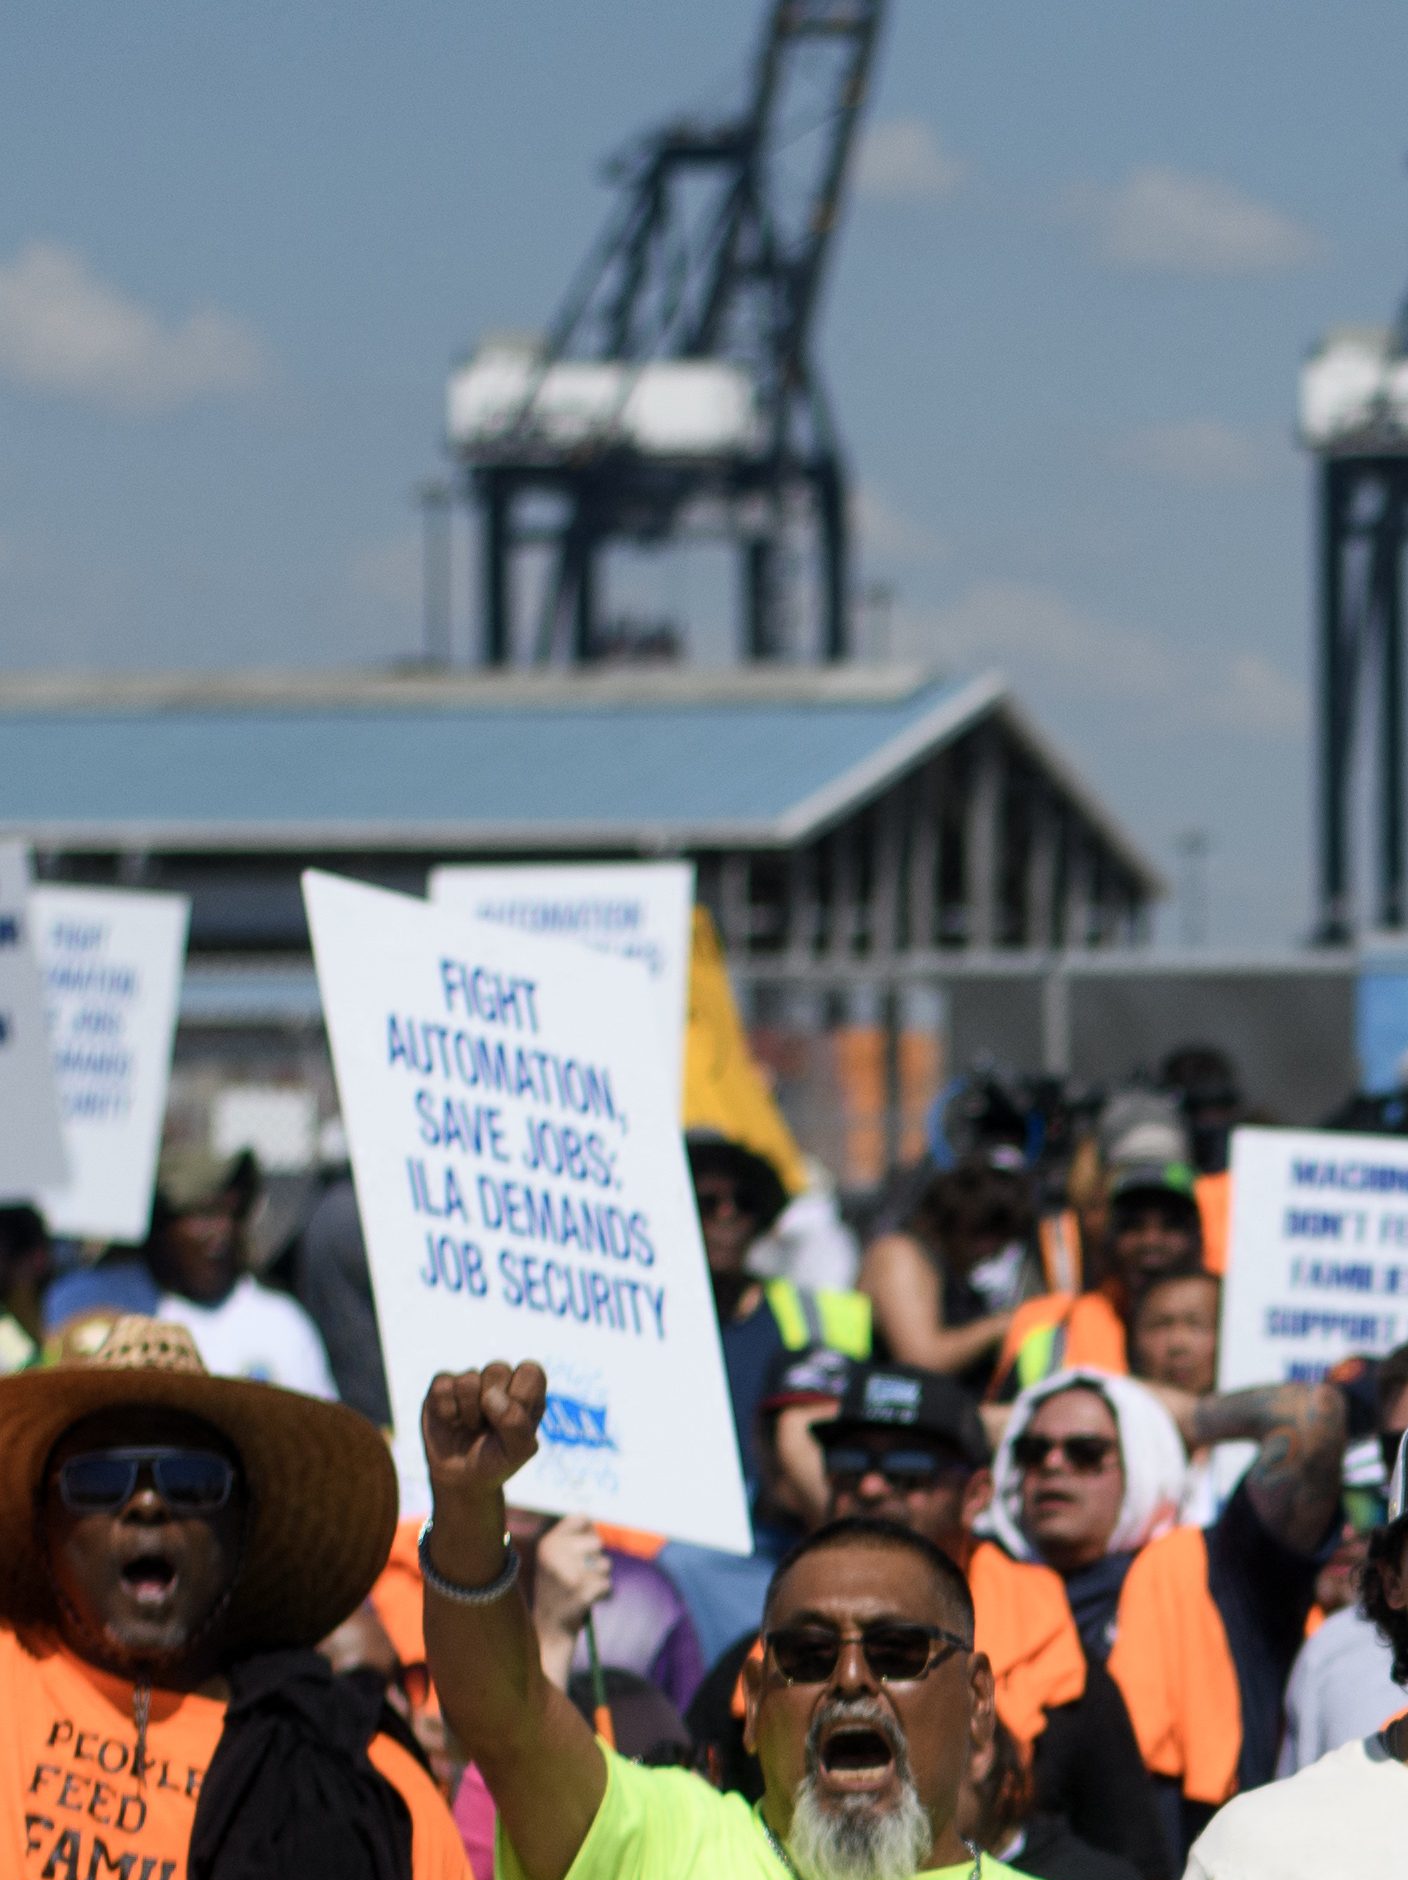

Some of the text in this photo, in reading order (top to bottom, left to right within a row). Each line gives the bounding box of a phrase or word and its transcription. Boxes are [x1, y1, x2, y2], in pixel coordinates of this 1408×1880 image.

[439, 958, 539, 1031] FIGHT
[389, 1014, 627, 1134] AUTOMATION,
[416, 1091, 622, 1190] SAVE JOBS:
[408, 1159, 655, 1268] ILA DEMANDS
[420, 1234, 665, 1340] JOB SECURITY
[29, 1764, 147, 1834] FEED
